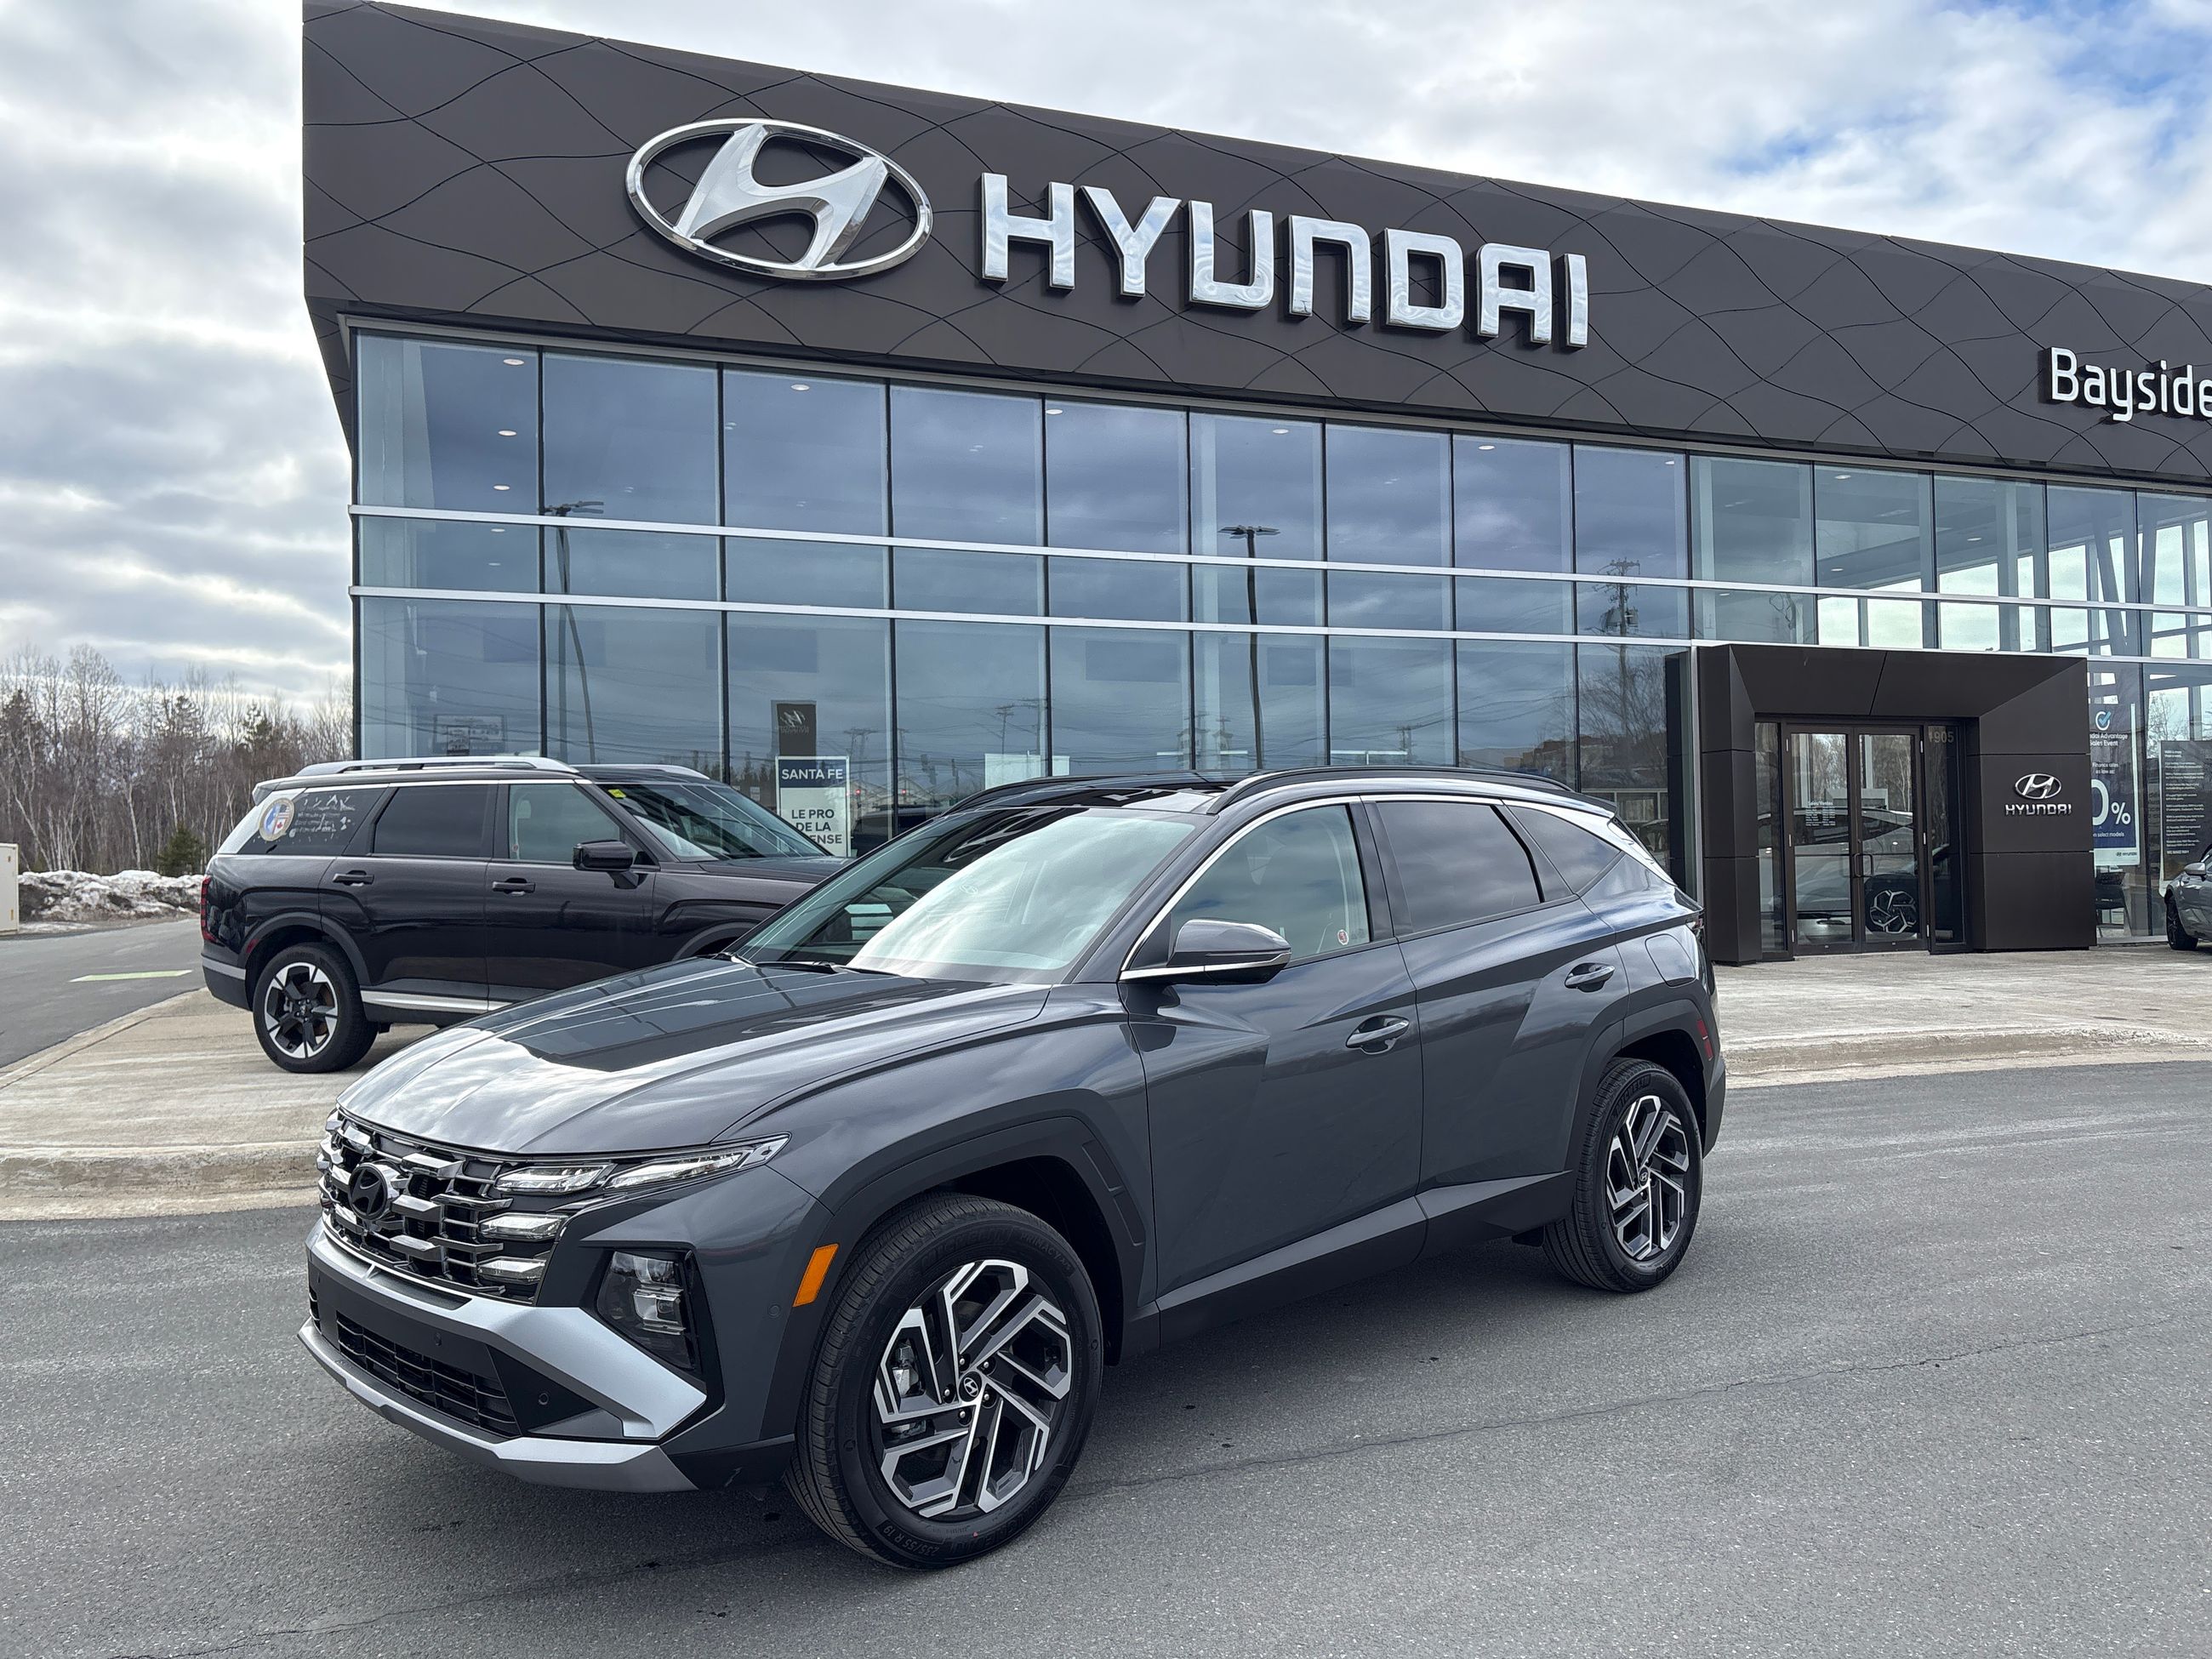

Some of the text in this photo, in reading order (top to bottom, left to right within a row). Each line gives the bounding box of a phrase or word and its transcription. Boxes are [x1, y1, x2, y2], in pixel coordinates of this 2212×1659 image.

[981, 173, 1588, 348] HYUNDAI
[2051, 346, 2212, 422] Bayside
[781, 768, 844, 780] SANTA FE
[792, 809, 835, 819] LE PRO
[2005, 804, 2072, 815] HYUNDAI
[796, 822, 832, 832] DE LA
[883, 1525, 940, 1557] 235/55 R 19
